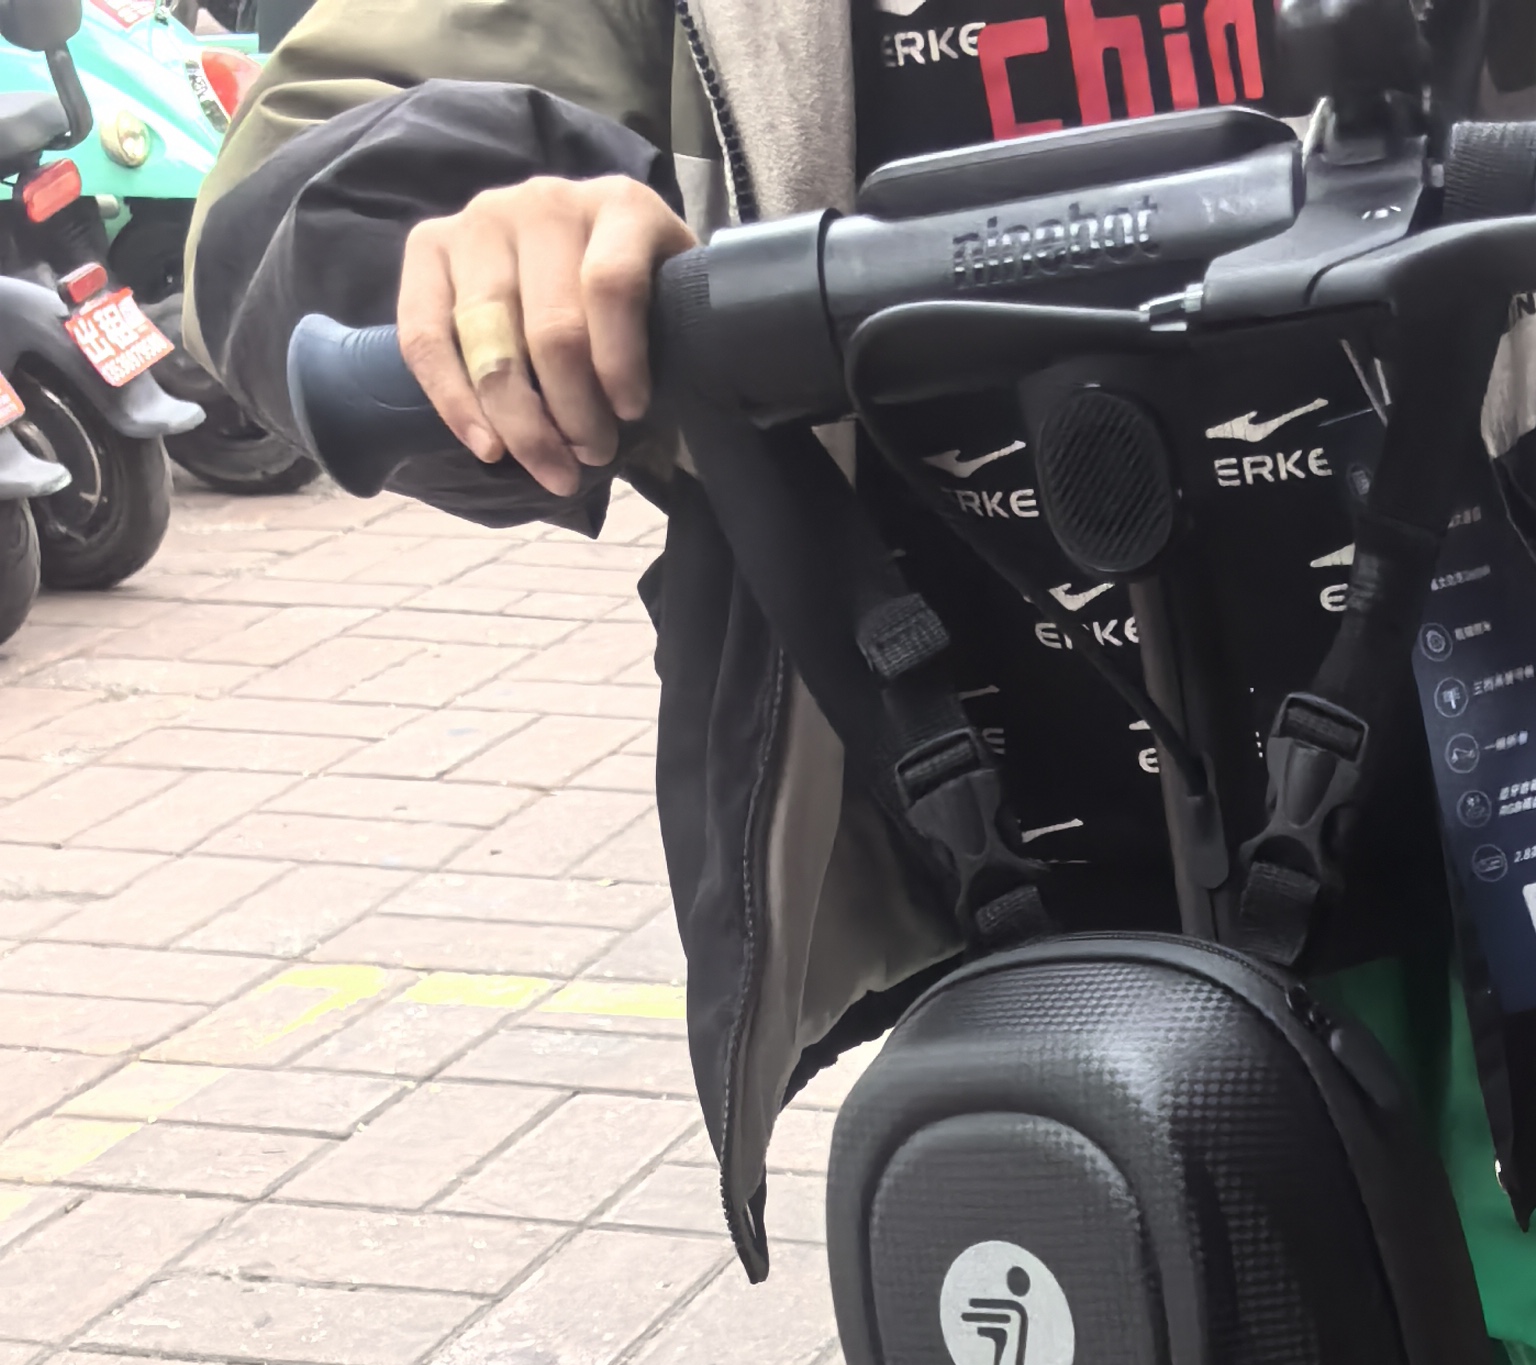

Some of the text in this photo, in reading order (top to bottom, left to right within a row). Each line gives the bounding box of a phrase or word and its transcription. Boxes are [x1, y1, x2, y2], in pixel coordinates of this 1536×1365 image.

[882, 21, 988, 68] ERKE
[952, 195, 1160, 290] ninebot
[1214, 447, 1333, 487] ERKE
[944, 487, 1040, 519] RKE
[1034, 615, 1141, 650] EKE
